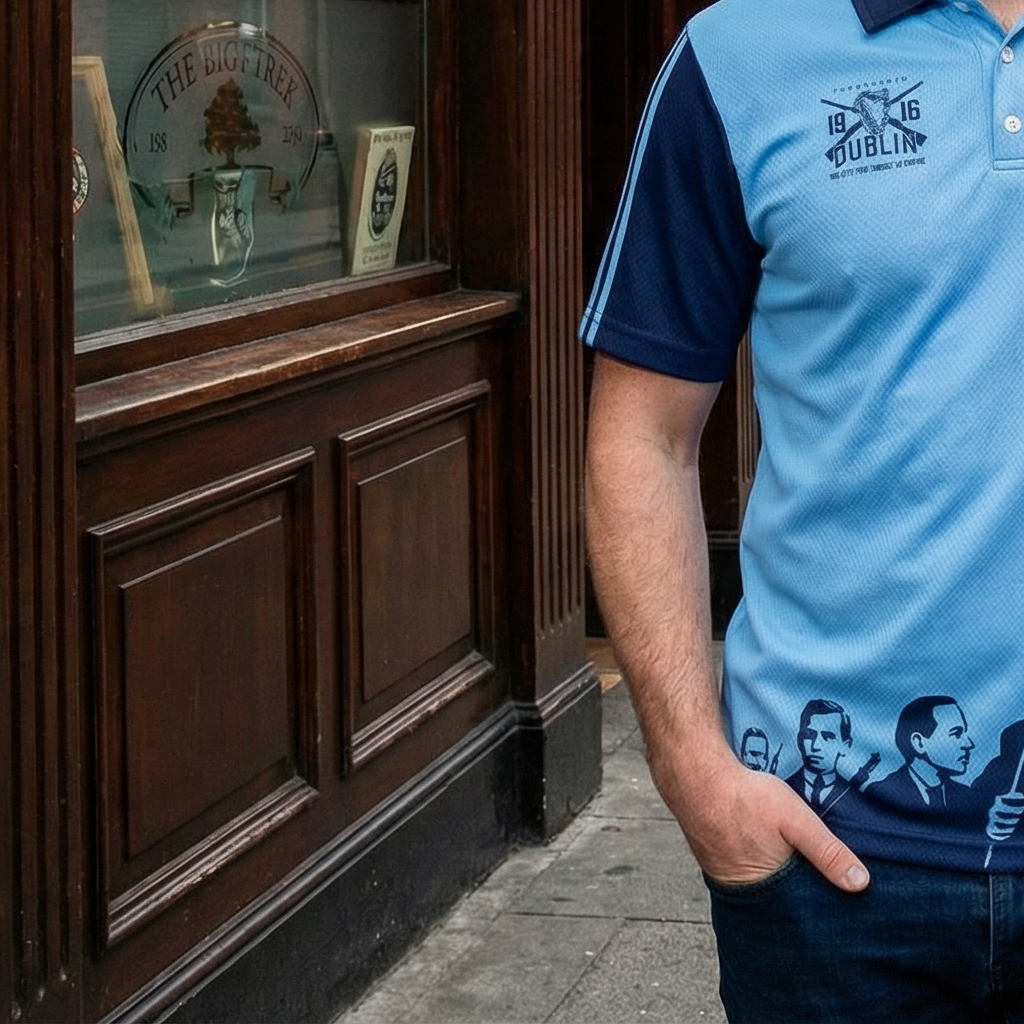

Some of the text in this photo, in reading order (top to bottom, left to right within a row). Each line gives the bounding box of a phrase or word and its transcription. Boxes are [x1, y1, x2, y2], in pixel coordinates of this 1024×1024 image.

[151, 52, 198, 114] THE
[828, 99, 921, 136] 19 16
[834, 132, 918, 169] DUBLIN
